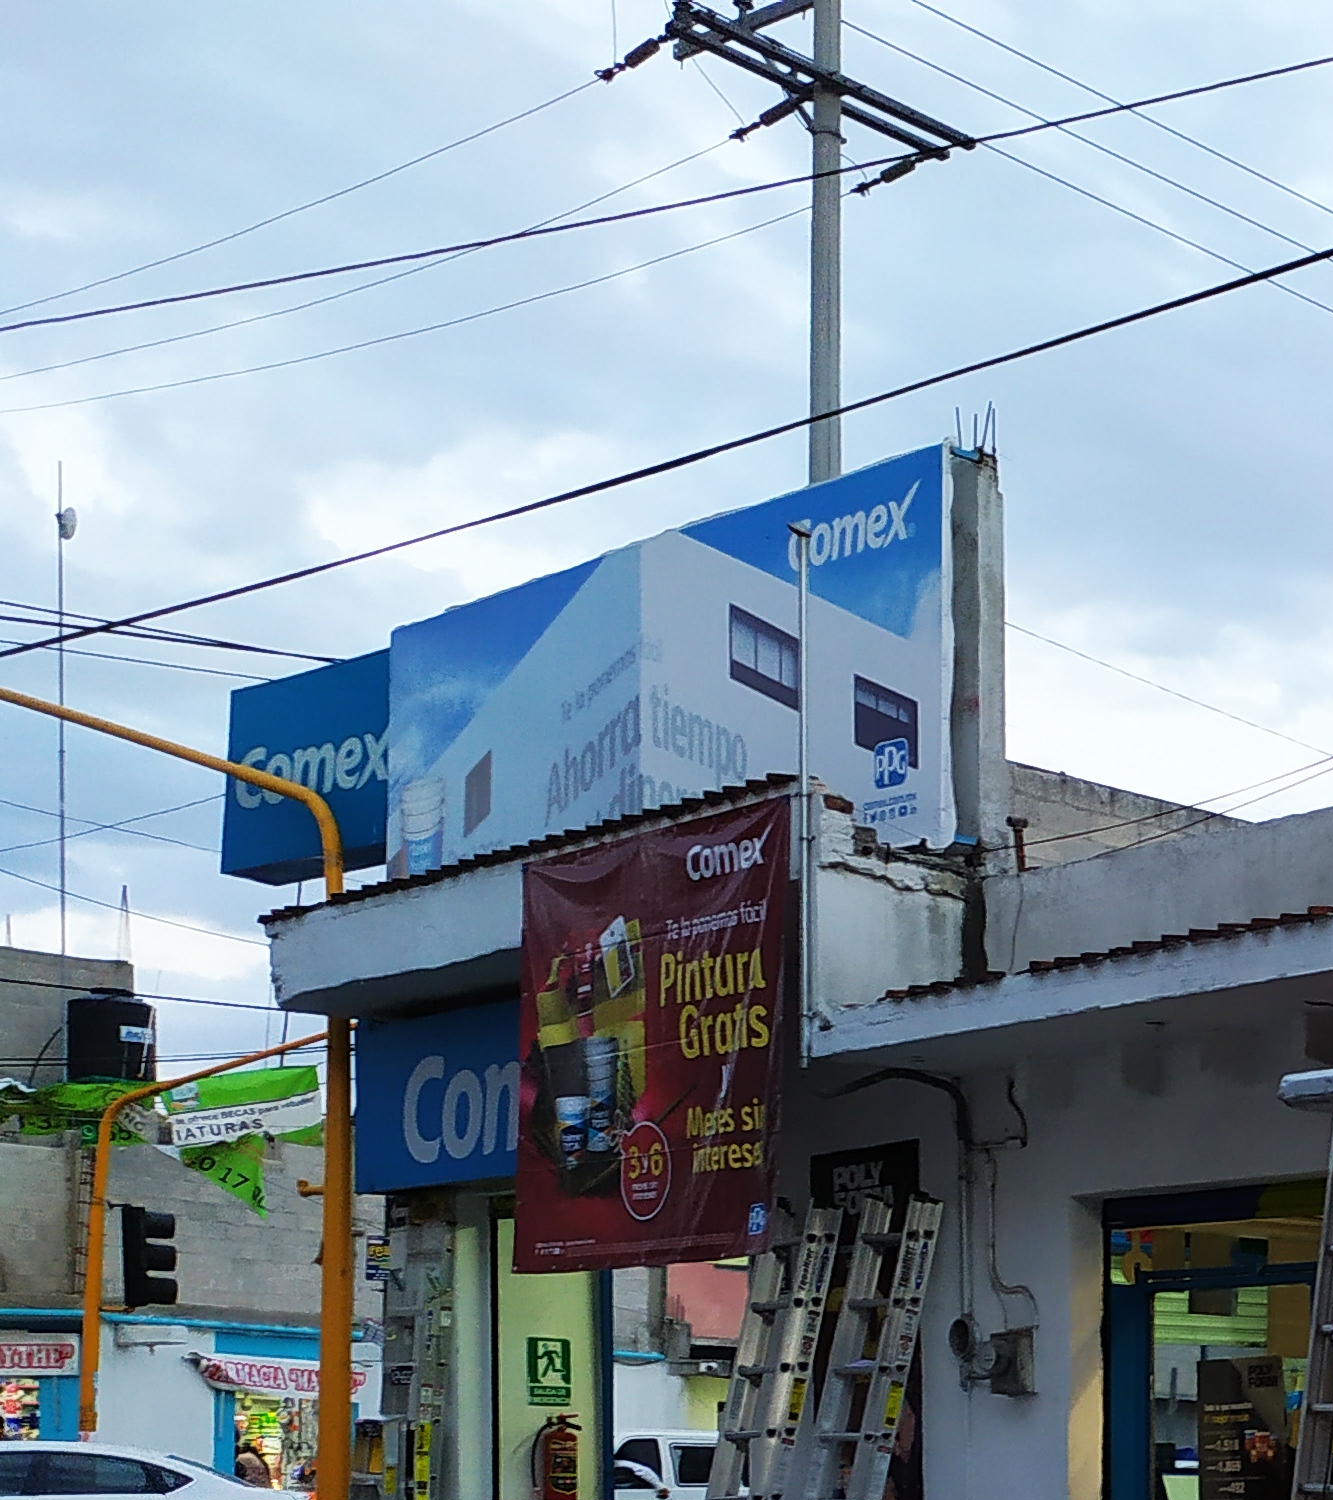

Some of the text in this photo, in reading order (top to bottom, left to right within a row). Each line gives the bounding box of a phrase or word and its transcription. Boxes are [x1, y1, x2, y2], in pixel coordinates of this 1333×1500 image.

[235, 732, 389, 809] Comex
[545, 683, 748, 827] Ahorra tiempo
[876, 746, 908, 785] PPG
[686, 822, 774, 881] Comex
[660, 948, 767, 1008] Pintura
[679, 1003, 770, 1059] Gratis
[221, 1107, 256, 1119] BECAS
